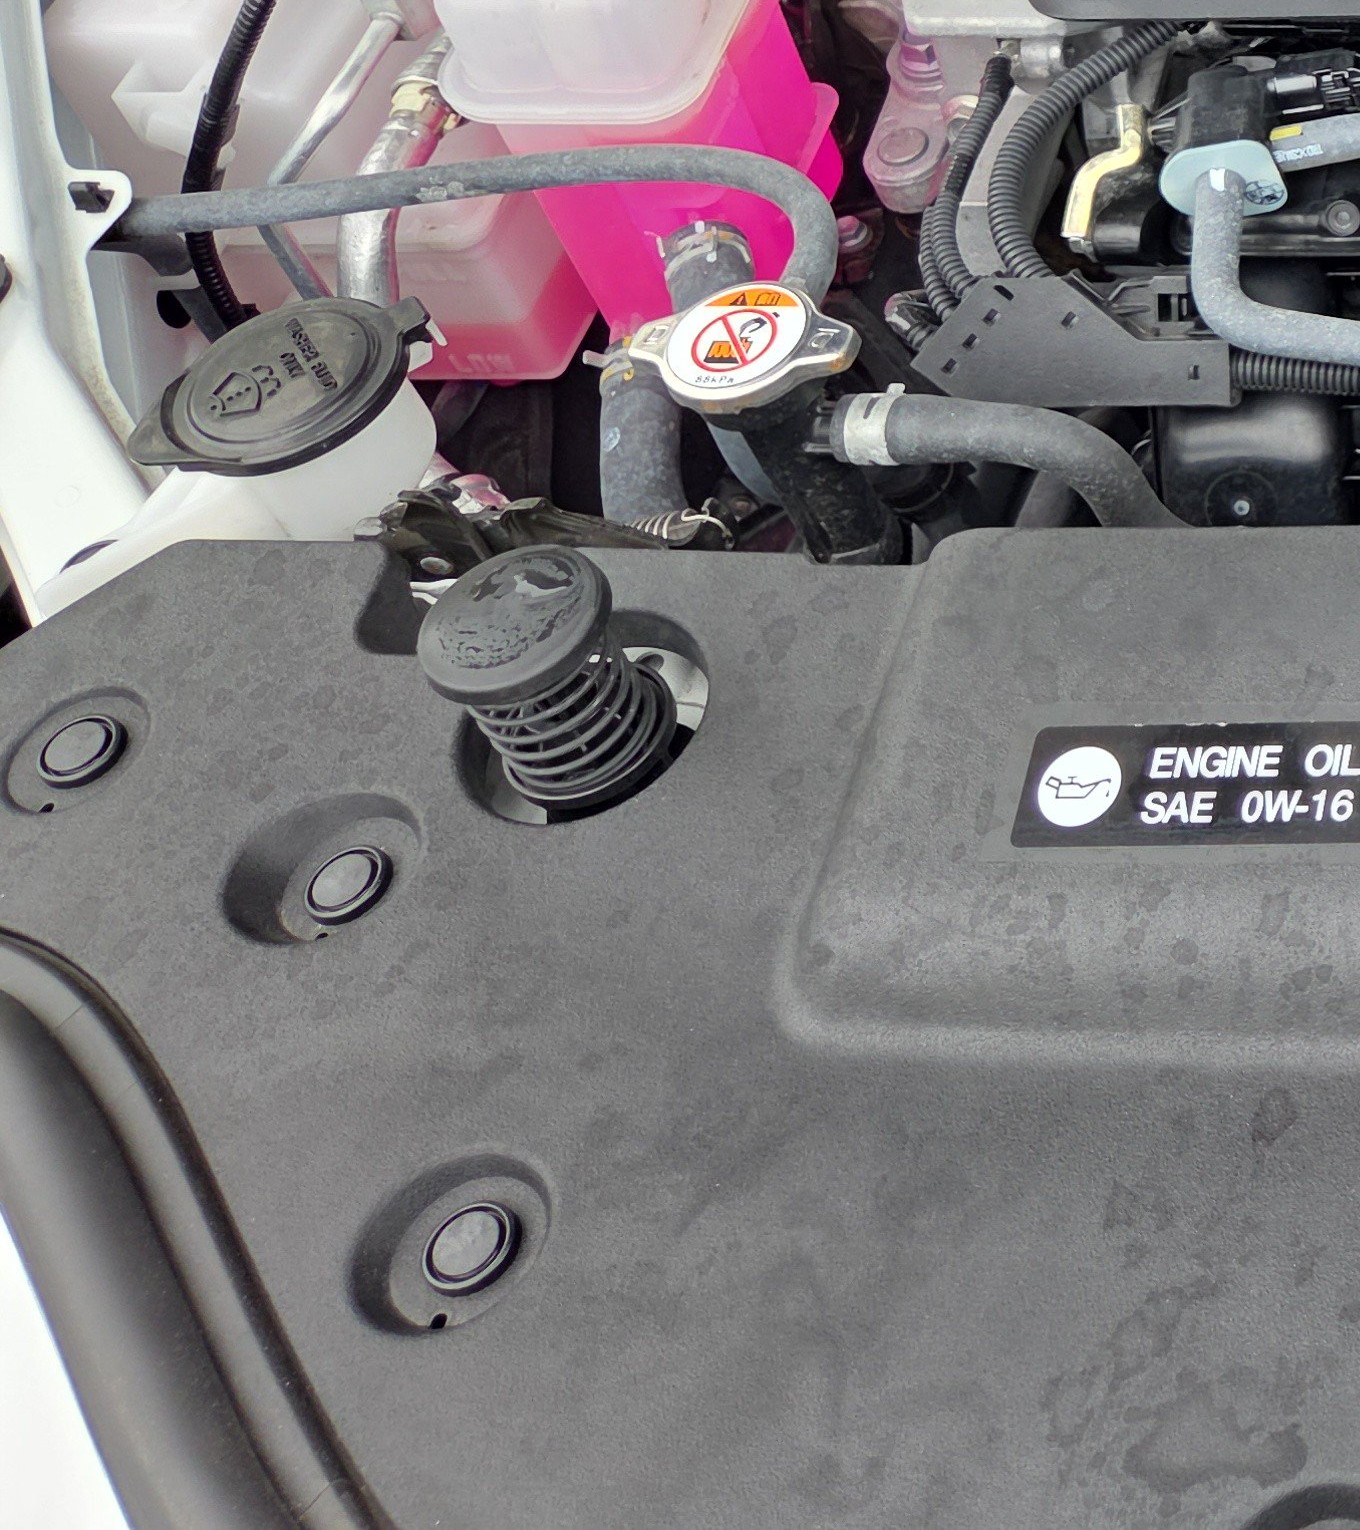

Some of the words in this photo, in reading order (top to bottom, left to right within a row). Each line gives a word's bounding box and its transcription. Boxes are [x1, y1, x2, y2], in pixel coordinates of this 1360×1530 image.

[1149, 745, 1283, 779] ENGINE
[1140, 790, 1217, 825] SAE
[1240, 789, 1356, 824] 0W-16
